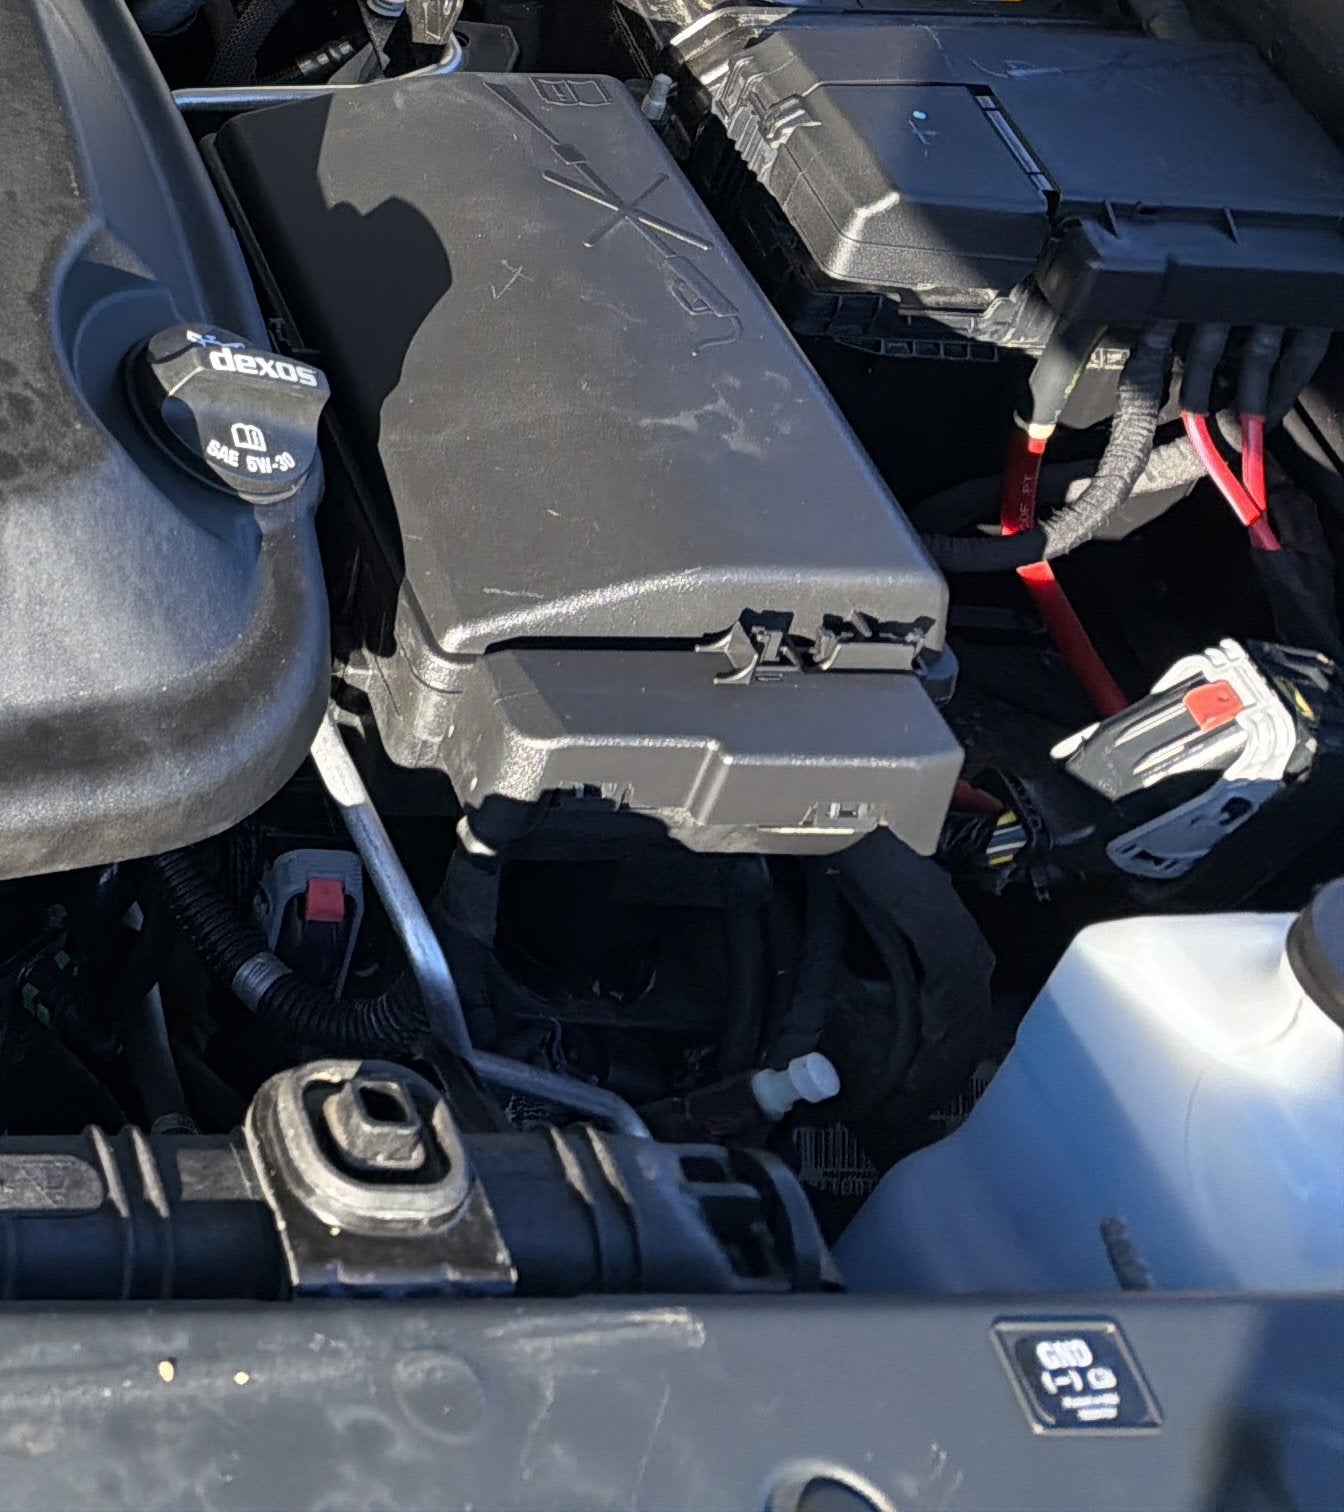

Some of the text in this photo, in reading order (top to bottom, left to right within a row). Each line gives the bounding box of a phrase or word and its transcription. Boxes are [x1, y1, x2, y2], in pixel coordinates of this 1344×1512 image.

[208, 347, 318, 387] dexos
[206, 439, 296, 474] SAE 5W-30
[1036, 1338, 1093, 1370] GND
